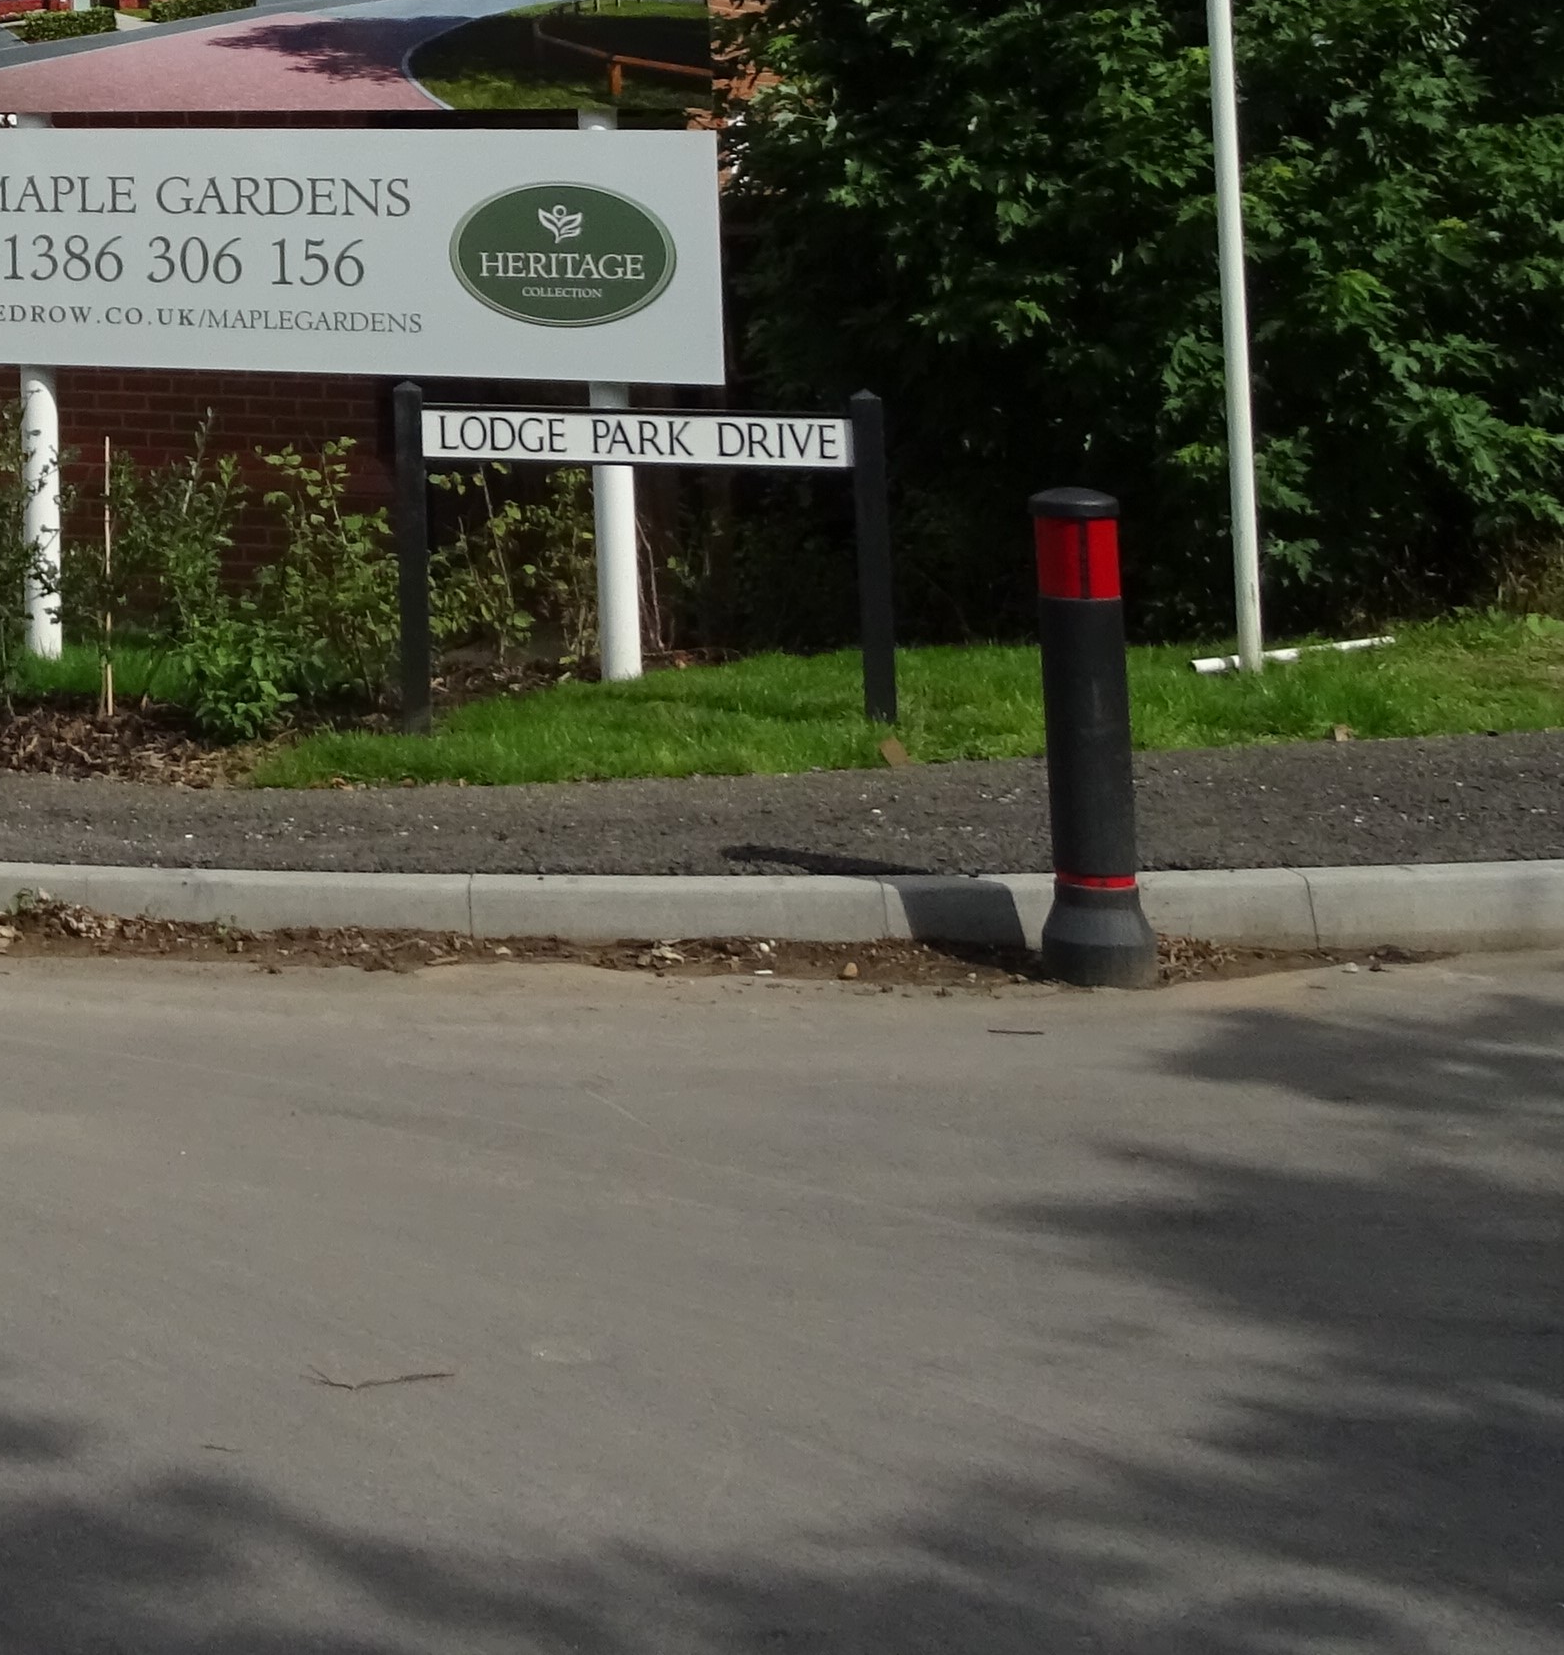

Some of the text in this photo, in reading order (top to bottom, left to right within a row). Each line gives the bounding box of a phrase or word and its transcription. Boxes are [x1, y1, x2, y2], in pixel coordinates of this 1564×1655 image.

[155, 176, 412, 219] GARDENS
[146, 235, 244, 286] 306
[270, 237, 366, 288] 156
[479, 251, 646, 280] HERITAGE
[522, 285, 603, 299] COLLECTION
[439, 414, 841, 460] LODGE PARK DRIVE
